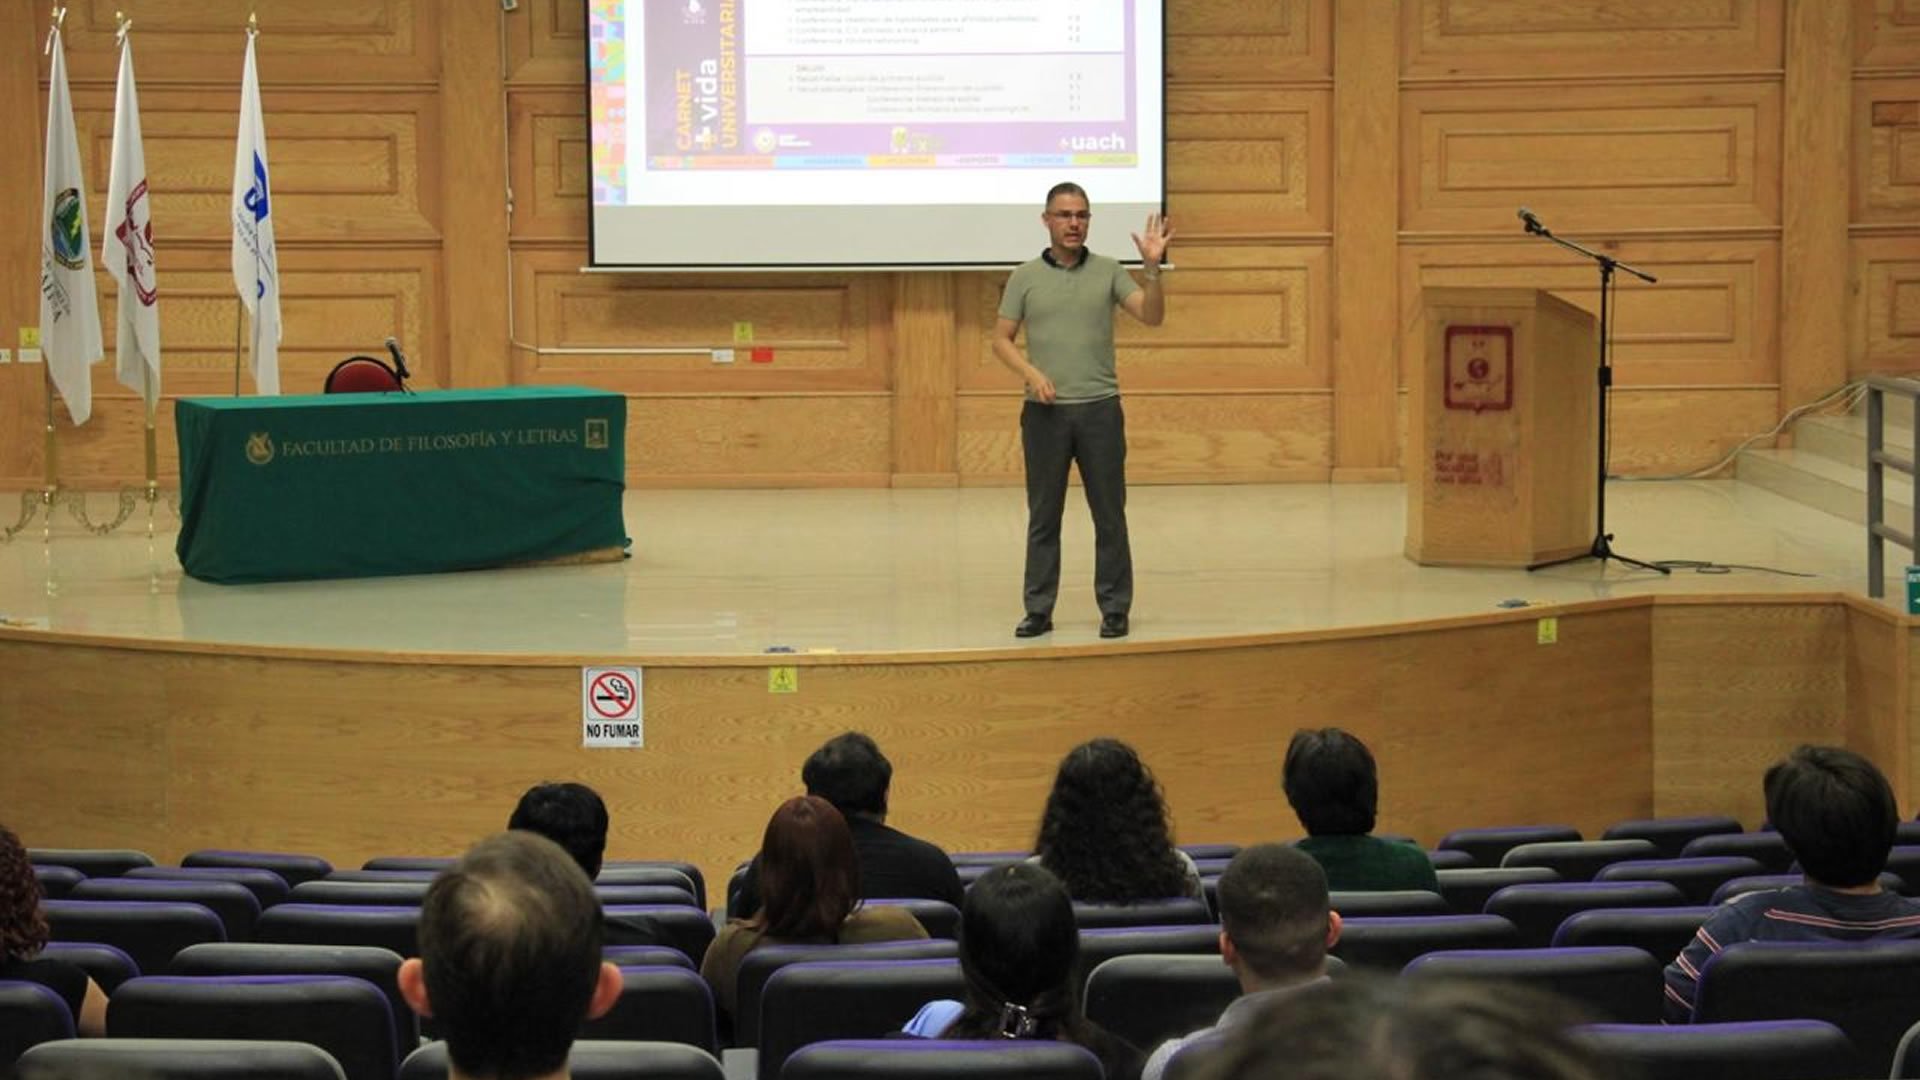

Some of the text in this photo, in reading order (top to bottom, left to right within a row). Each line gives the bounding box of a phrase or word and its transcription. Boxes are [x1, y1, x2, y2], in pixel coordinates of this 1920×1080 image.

[693, 59, 719, 121] vida
[719, 0, 737, 148] UNIVERSITARI
[675, 68, 692, 152] CARNET
[1071, 132, 1126, 151] uach
[282, 428, 577, 457] FACULTAD DE FILOSOFÍA Y LETRAS
[586, 723, 640, 738] NO FUMAR
